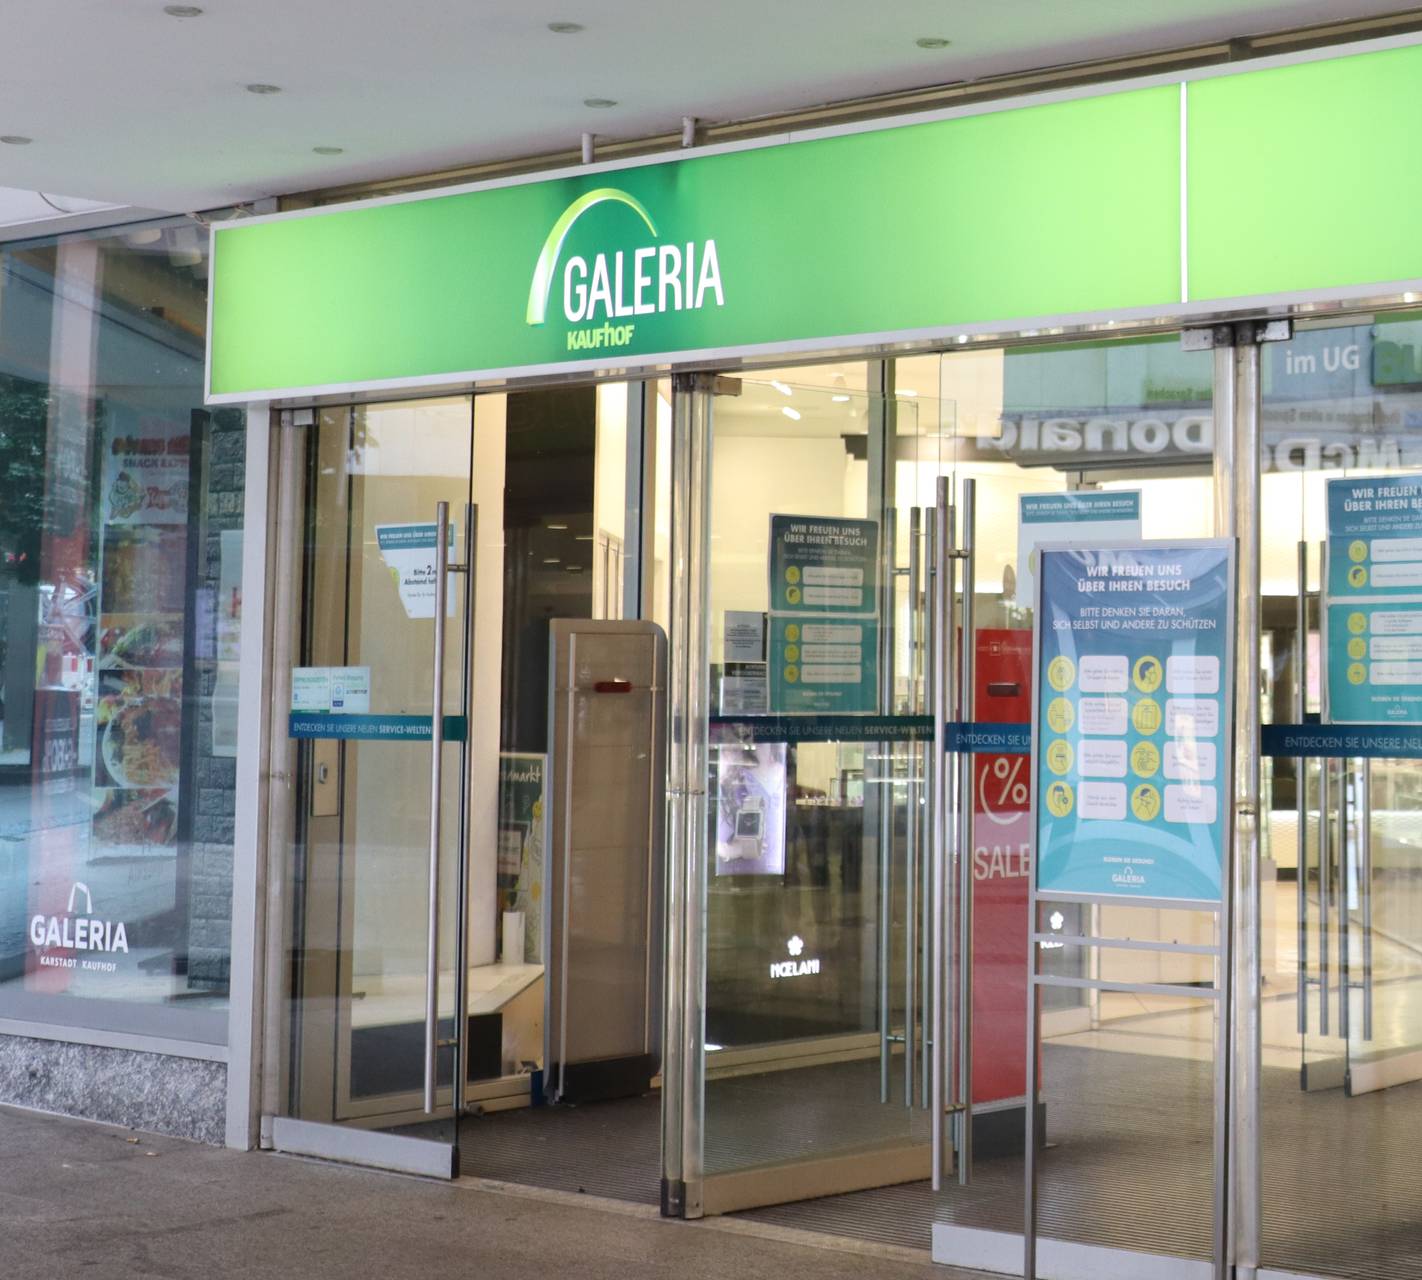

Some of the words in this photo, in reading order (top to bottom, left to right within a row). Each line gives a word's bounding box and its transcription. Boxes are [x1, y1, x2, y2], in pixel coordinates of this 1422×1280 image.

[563, 238, 724, 322] GALERIA
[1286, 350, 1316, 375] im
[1323, 345, 1360, 371] UG
[1352, 488, 1374, 498] WIR
[1378, 486, 1417, 498] FREUEN
[1344, 499, 1371, 511] ÜBER
[1375, 499, 1408, 510] IHREN
[790, 523, 807, 534] WIR
[809, 525, 840, 536] FREUEN
[842, 527, 861, 536] UNS
[784, 531, 805, 543] ÜBER
[807, 535, 832, 545] IHREN
[834, 536, 867, 546] BESUCH
[1086, 566, 1108, 577] WIR
[1111, 565, 1154, 577] FREUEN
[1157, 564, 1182, 576] UNS
[1078, 579, 1105, 592] ÜBER
[1109, 580, 1143, 592] IHREN
[1146, 579, 1190, 591] BESUCH
[1080, 607, 1100, 617] BITTE
[1102, 607, 1136, 617] DENKEN
[1138, 607, 1151, 617] SIE
[1152, 607, 1186, 618] DARAN,
[1053, 620, 1071, 630] SICH
[1073, 620, 1098, 630] SELBST
[1101, 620, 1120, 630] UND
[1122, 620, 1155, 630] ANDERE
[1157, 620, 1169, 630] ZU
[1171, 617, 1216, 629] SCHÜTZEN
[294, 722, 325, 732] ENTDECKEN
[326, 723, 334, 732] SIE
[956, 733, 1009, 745] ENTDECKEN
[1011, 734, 1021, 745] SIE
[1285, 736, 1342, 748] ENTDECKEN
[1344, 736, 1360, 748] SIE
[1362, 736, 1401, 749] UNSERE
[974, 845, 1030, 881] SALE
[1112, 873, 1145, 884] GALERIA
[30, 914, 129, 953] GALERIA
[40, 955, 77, 969] KARSTADT
[81, 959, 117, 973] KAUFHOF
